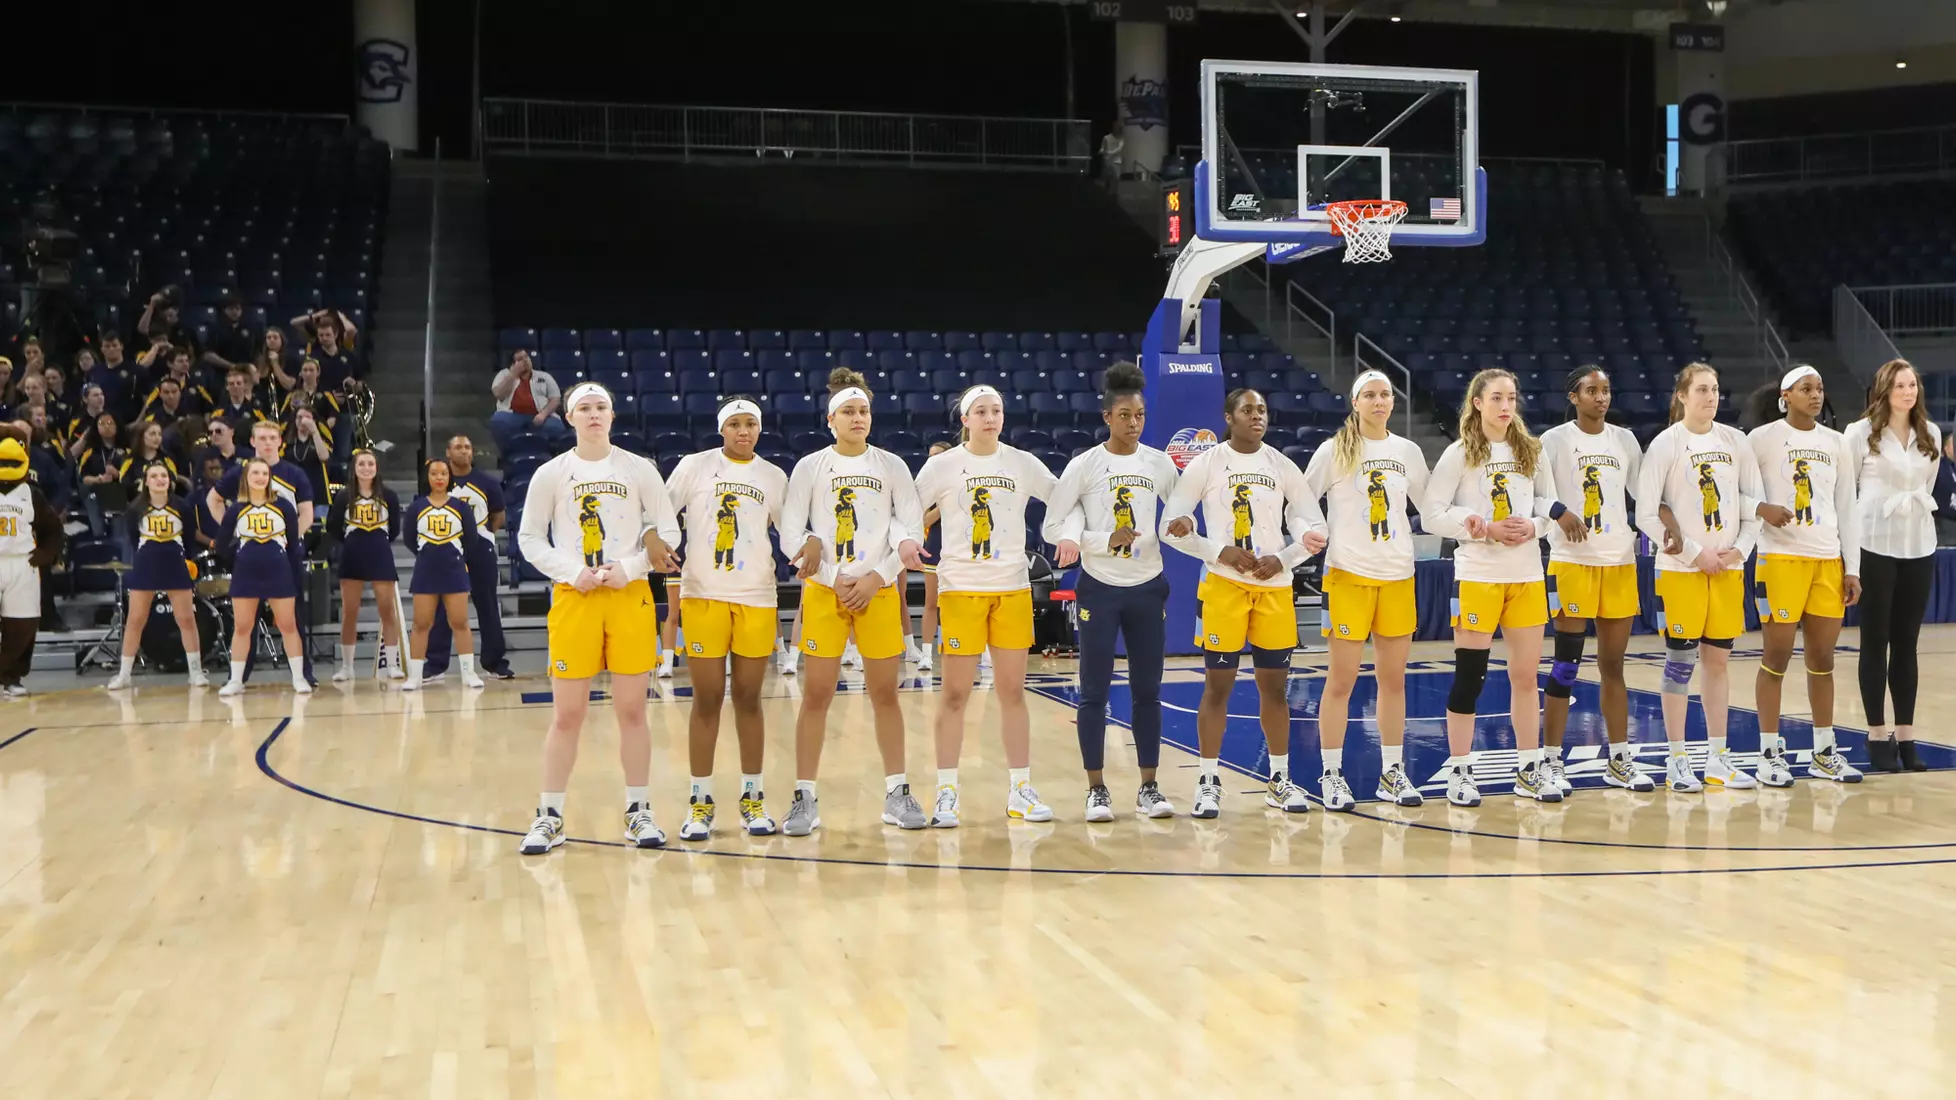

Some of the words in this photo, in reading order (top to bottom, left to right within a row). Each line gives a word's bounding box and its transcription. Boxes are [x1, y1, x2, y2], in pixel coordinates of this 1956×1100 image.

[1094, 2, 1121, 17] 102
[1167, 6, 1195, 21] 103
[1168, 362, 1213, 374] SPALDING
[1167, 444, 1188, 452] BIG
[1578, 454, 1620, 471] MARQUETTE
[1690, 451, 1733, 468] MARQUETTE
[1788, 449, 1831, 466] MARQUETTE
[1361, 459, 1406, 476] MARQUETTE
[832, 475, 882, 492] MARQUETTE
[966, 475, 1016, 492] MARQUETTE
[1109, 474, 1155, 492] MARQUETTE
[1228, 473, 1276, 490] MARQUETTE
[574, 481, 628, 500] MARQUETTE
[716, 482, 764, 505] MARQUETTE
[355, 503, 380, 526] MU
[148, 515, 174, 539] MU
[247, 512, 274, 536] MU
[427, 514, 452, 537] MU
